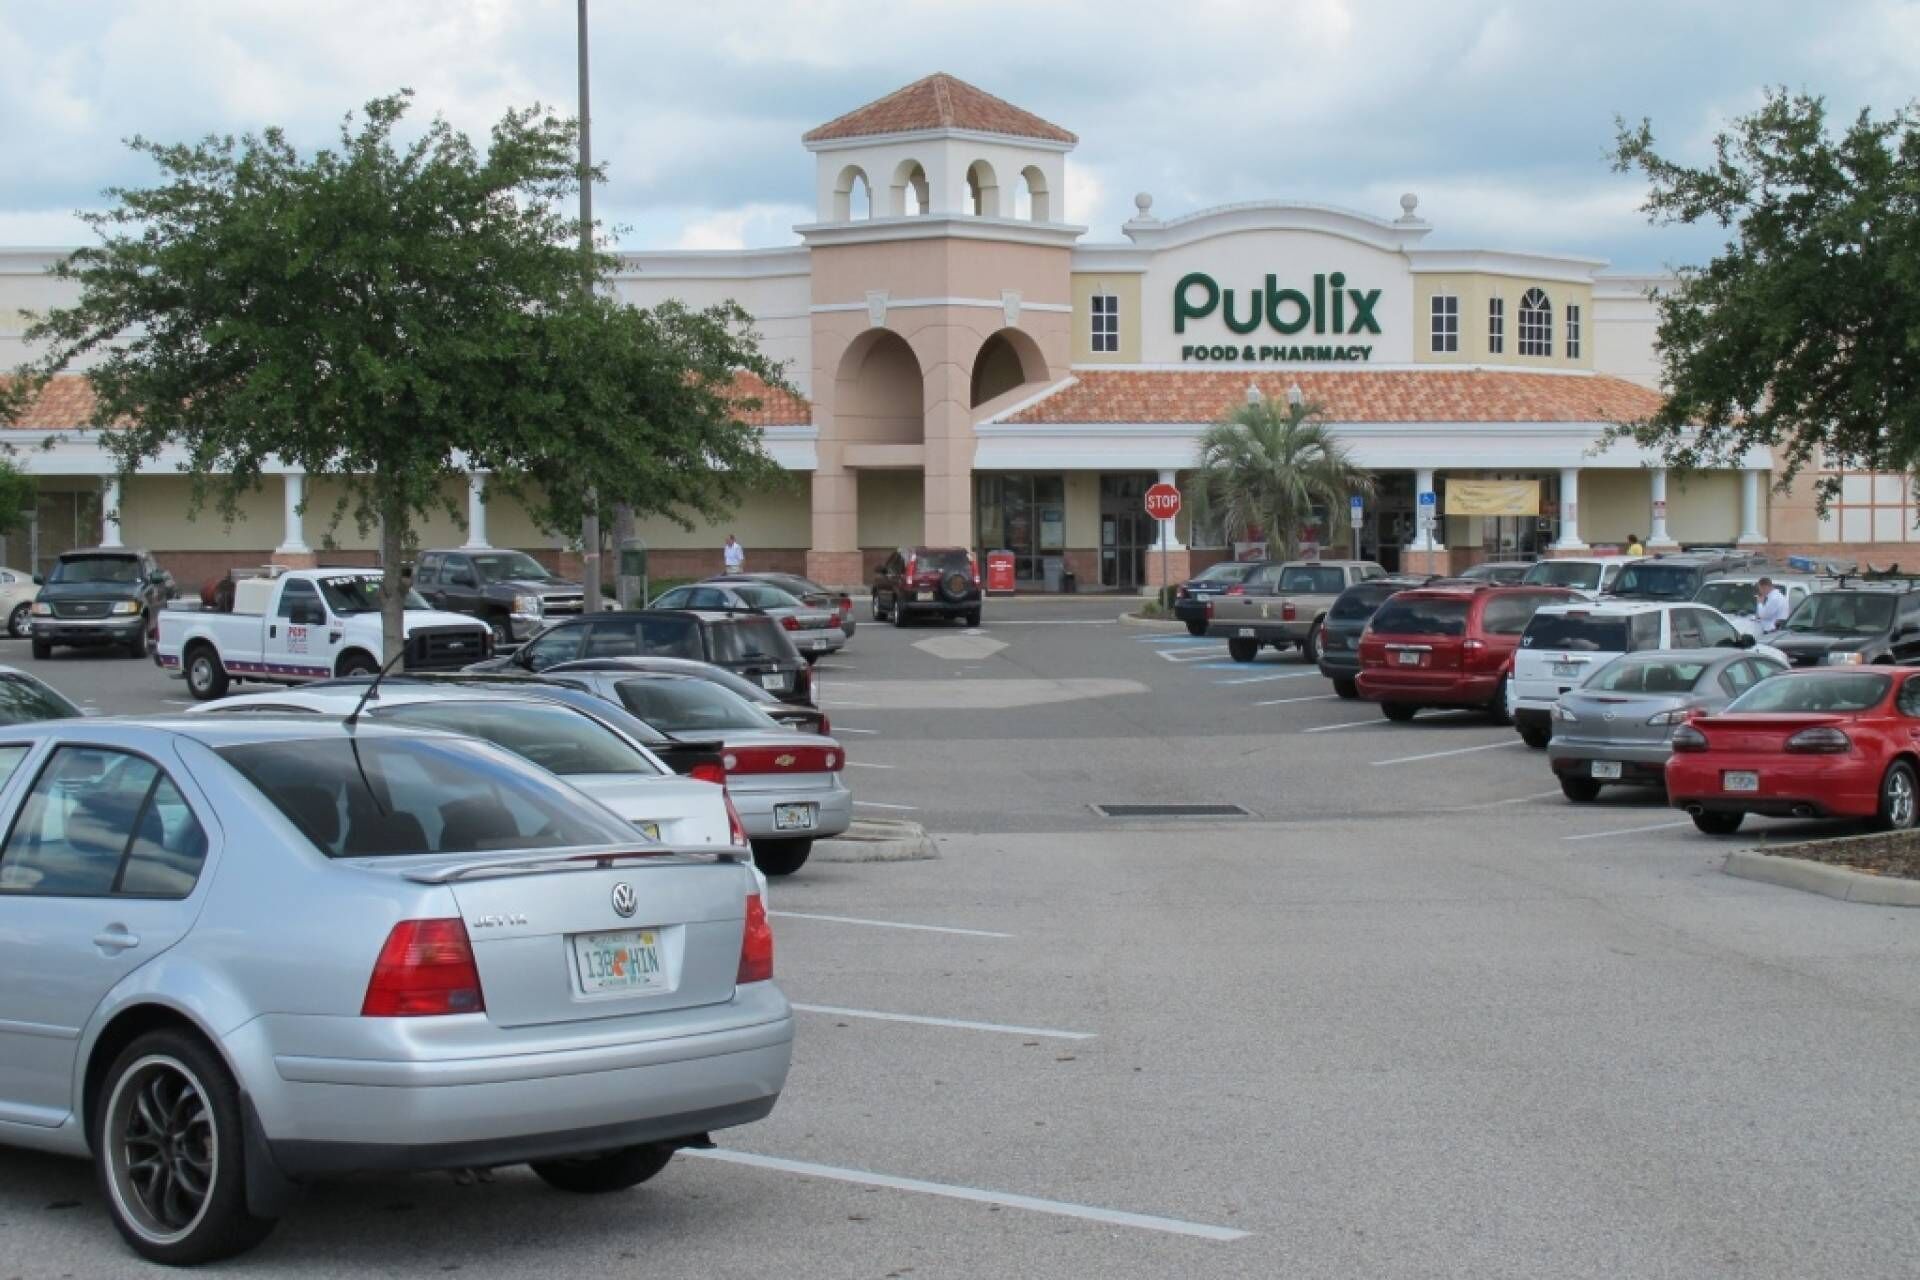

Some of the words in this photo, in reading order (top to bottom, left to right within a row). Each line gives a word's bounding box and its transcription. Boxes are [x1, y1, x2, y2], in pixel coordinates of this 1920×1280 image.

[1174, 271, 1383, 334] Publix
[1182, 345, 1239, 361] FOOD
[1241, 345, 1256, 361] &
[1259, 344, 1373, 361] PHARMACY
[1147, 495, 1178, 509] STOP
